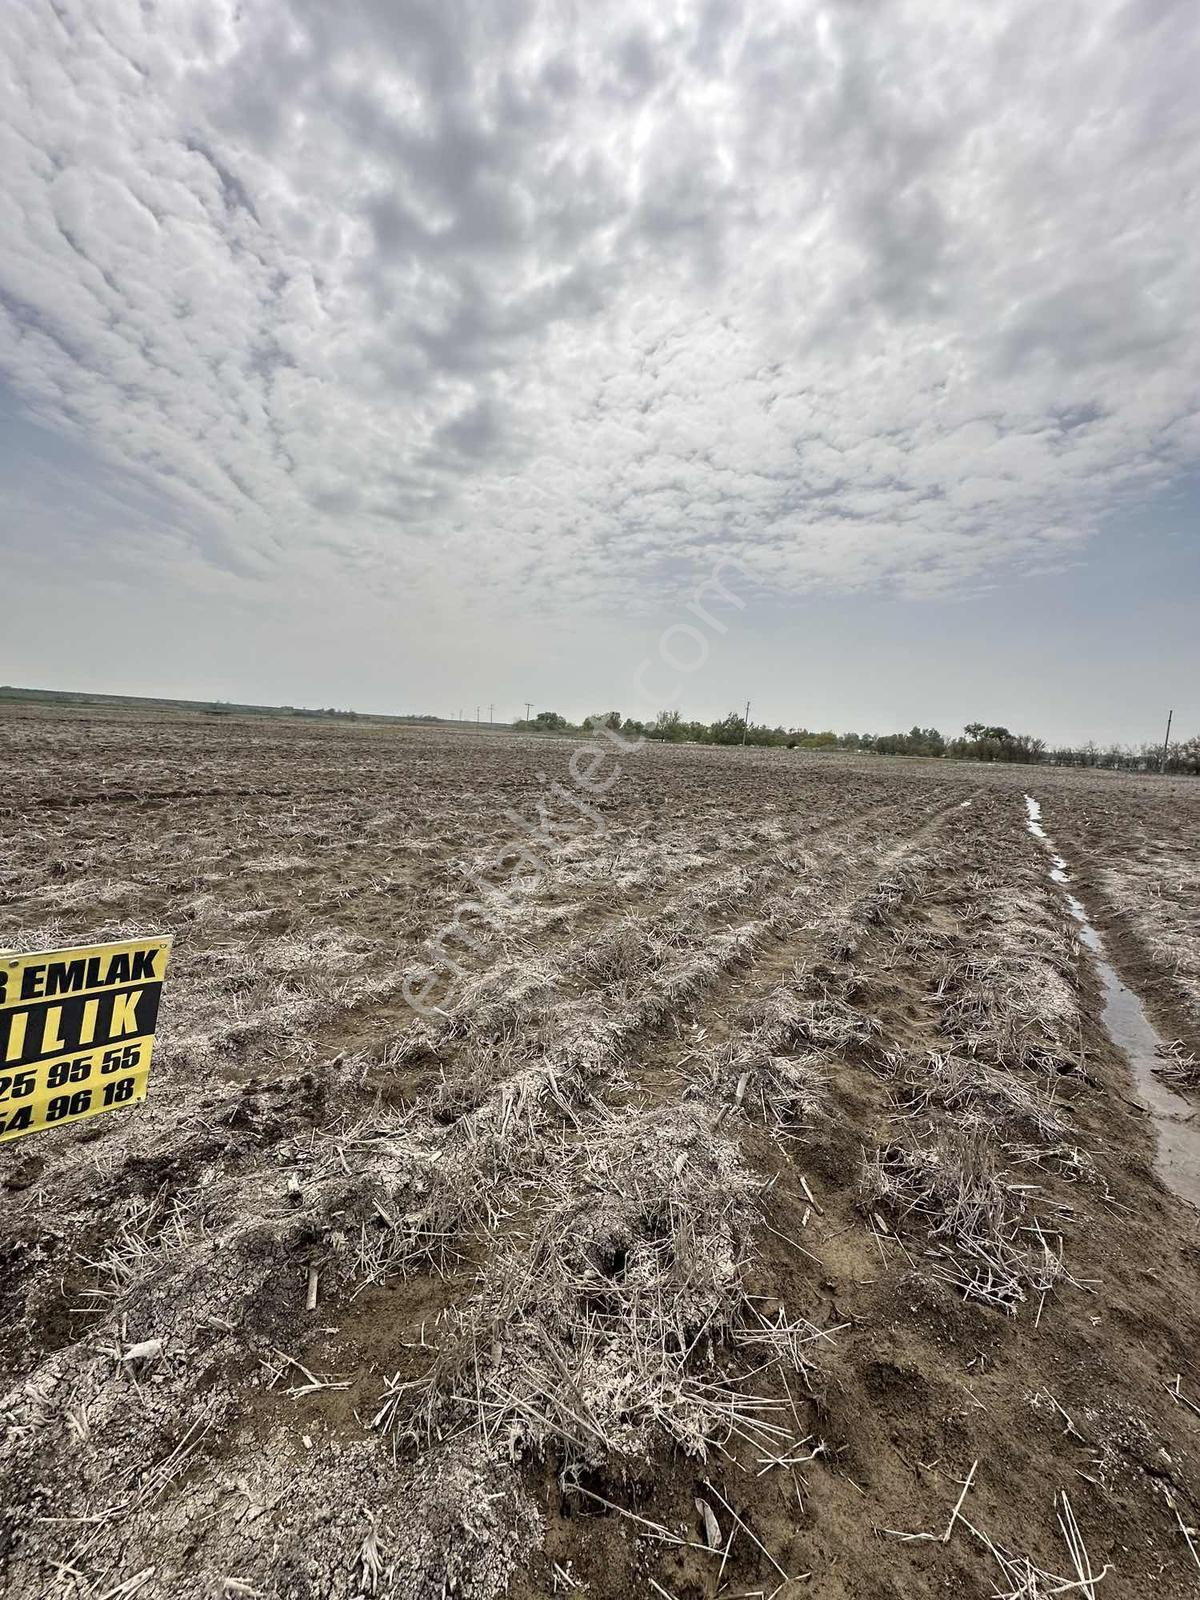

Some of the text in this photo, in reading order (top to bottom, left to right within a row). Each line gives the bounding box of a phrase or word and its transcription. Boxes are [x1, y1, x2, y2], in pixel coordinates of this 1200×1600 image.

[20, 949, 159, 1001] EMLAK
[47, 1055, 93, 1089] 95
[101, 1043, 142, 1074] 55
[46, 1089, 92, 1122] 96
[103, 1077, 136, 1107] 18
